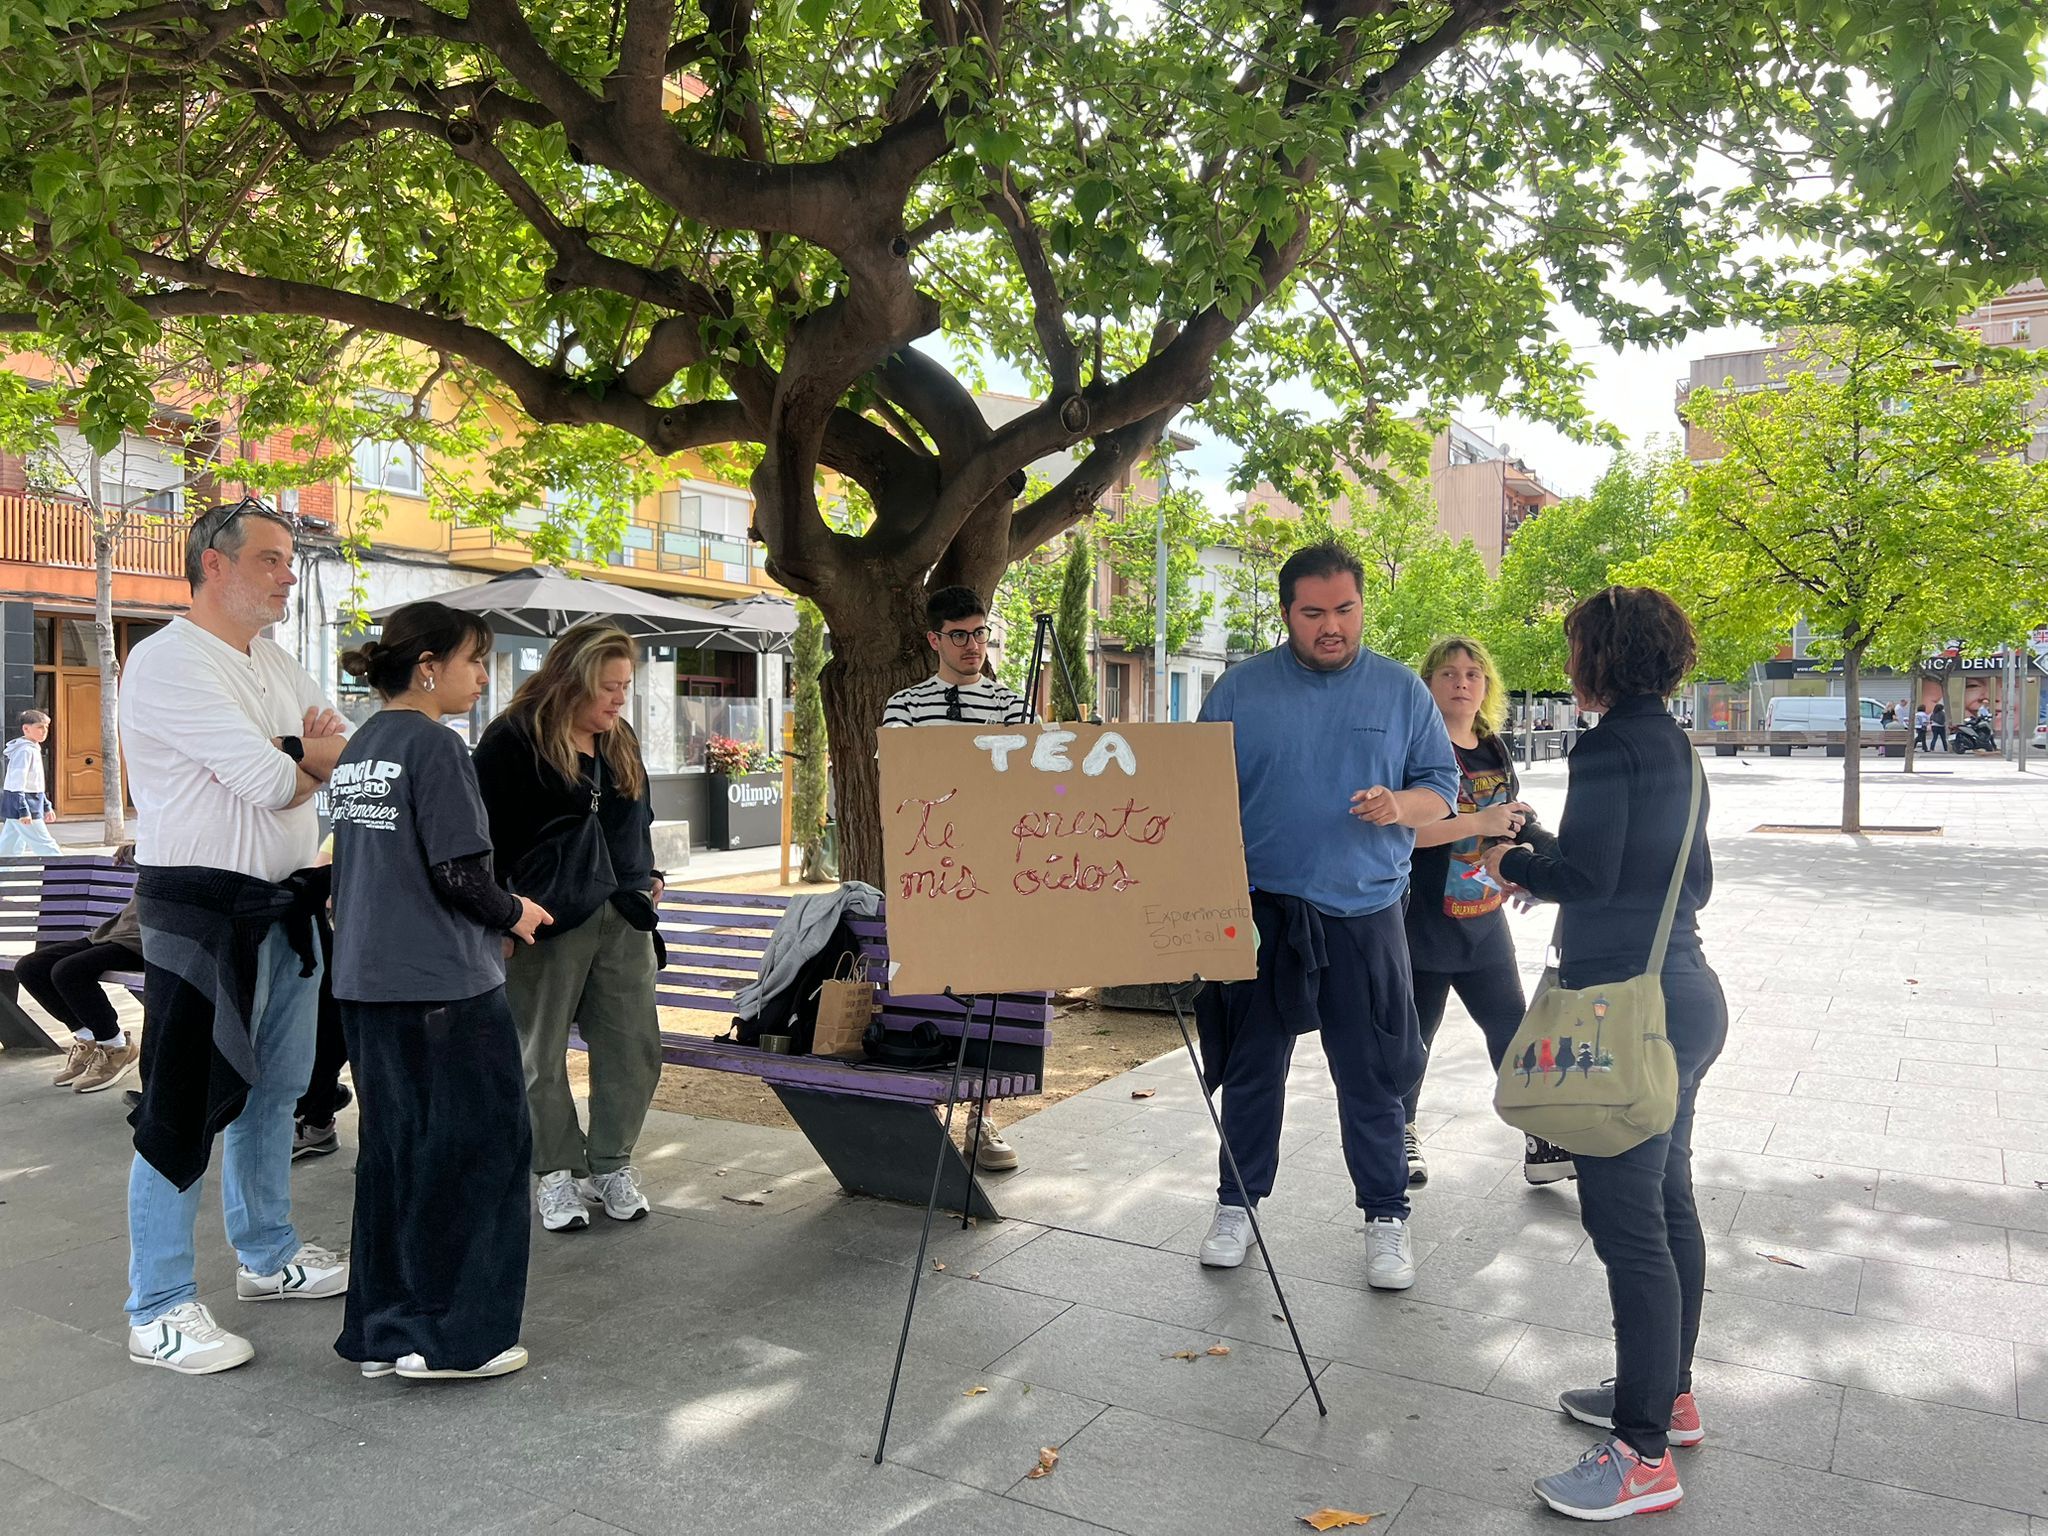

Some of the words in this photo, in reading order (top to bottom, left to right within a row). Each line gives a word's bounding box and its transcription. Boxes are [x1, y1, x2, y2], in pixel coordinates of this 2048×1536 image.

[364, 759, 402, 782] UP
[973, 730, 1137, 777] TEA
[896, 788, 964, 856] Te
[1011, 797, 1173, 863] presto
[899, 856, 990, 900] mis
[1142, 899, 1250, 928] Experimento
[1149, 923, 1222, 949] Social
